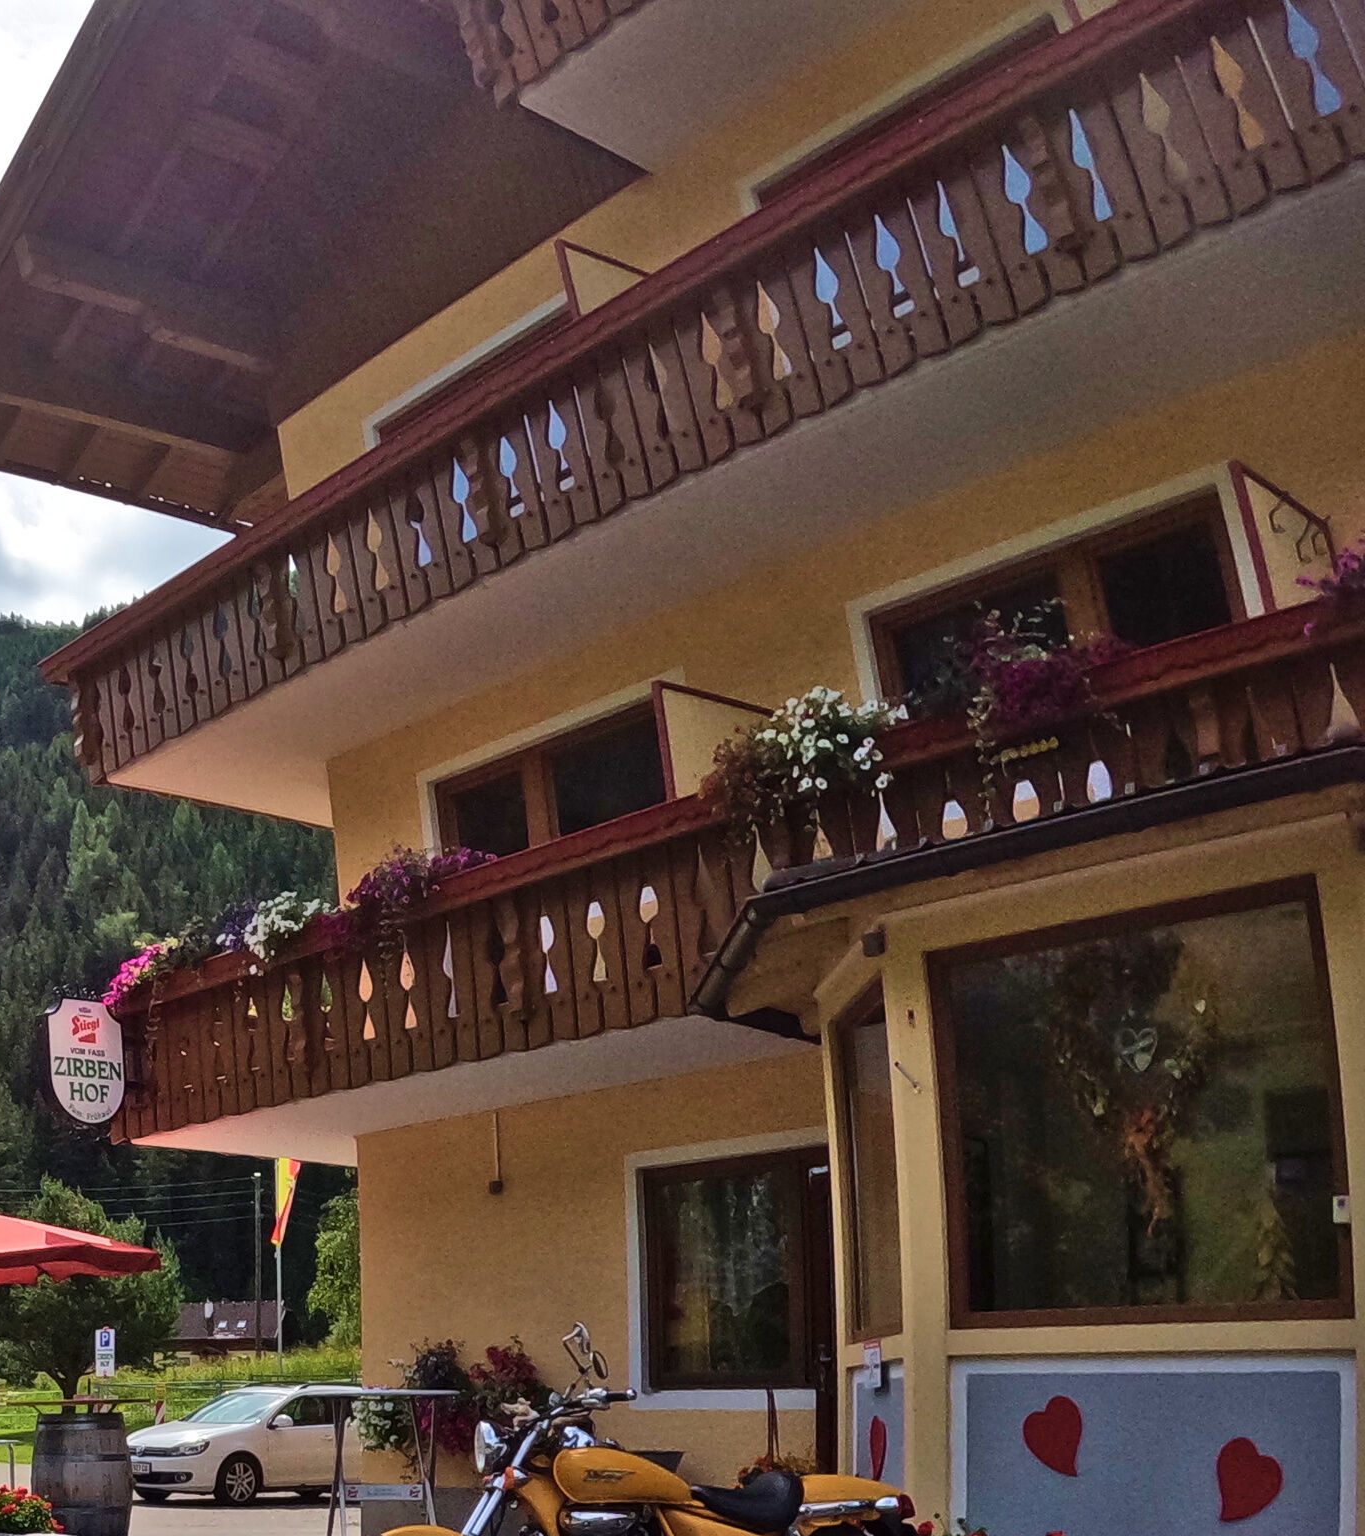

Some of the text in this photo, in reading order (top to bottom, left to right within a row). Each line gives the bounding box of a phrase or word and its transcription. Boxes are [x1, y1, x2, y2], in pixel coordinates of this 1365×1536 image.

[72, 1016, 100, 1036] Stiegl
[70, 1047, 106, 1057] VOM FASS
[53, 1056, 122, 1082] ZIRBEN
[69, 1081, 110, 1104] HOF
